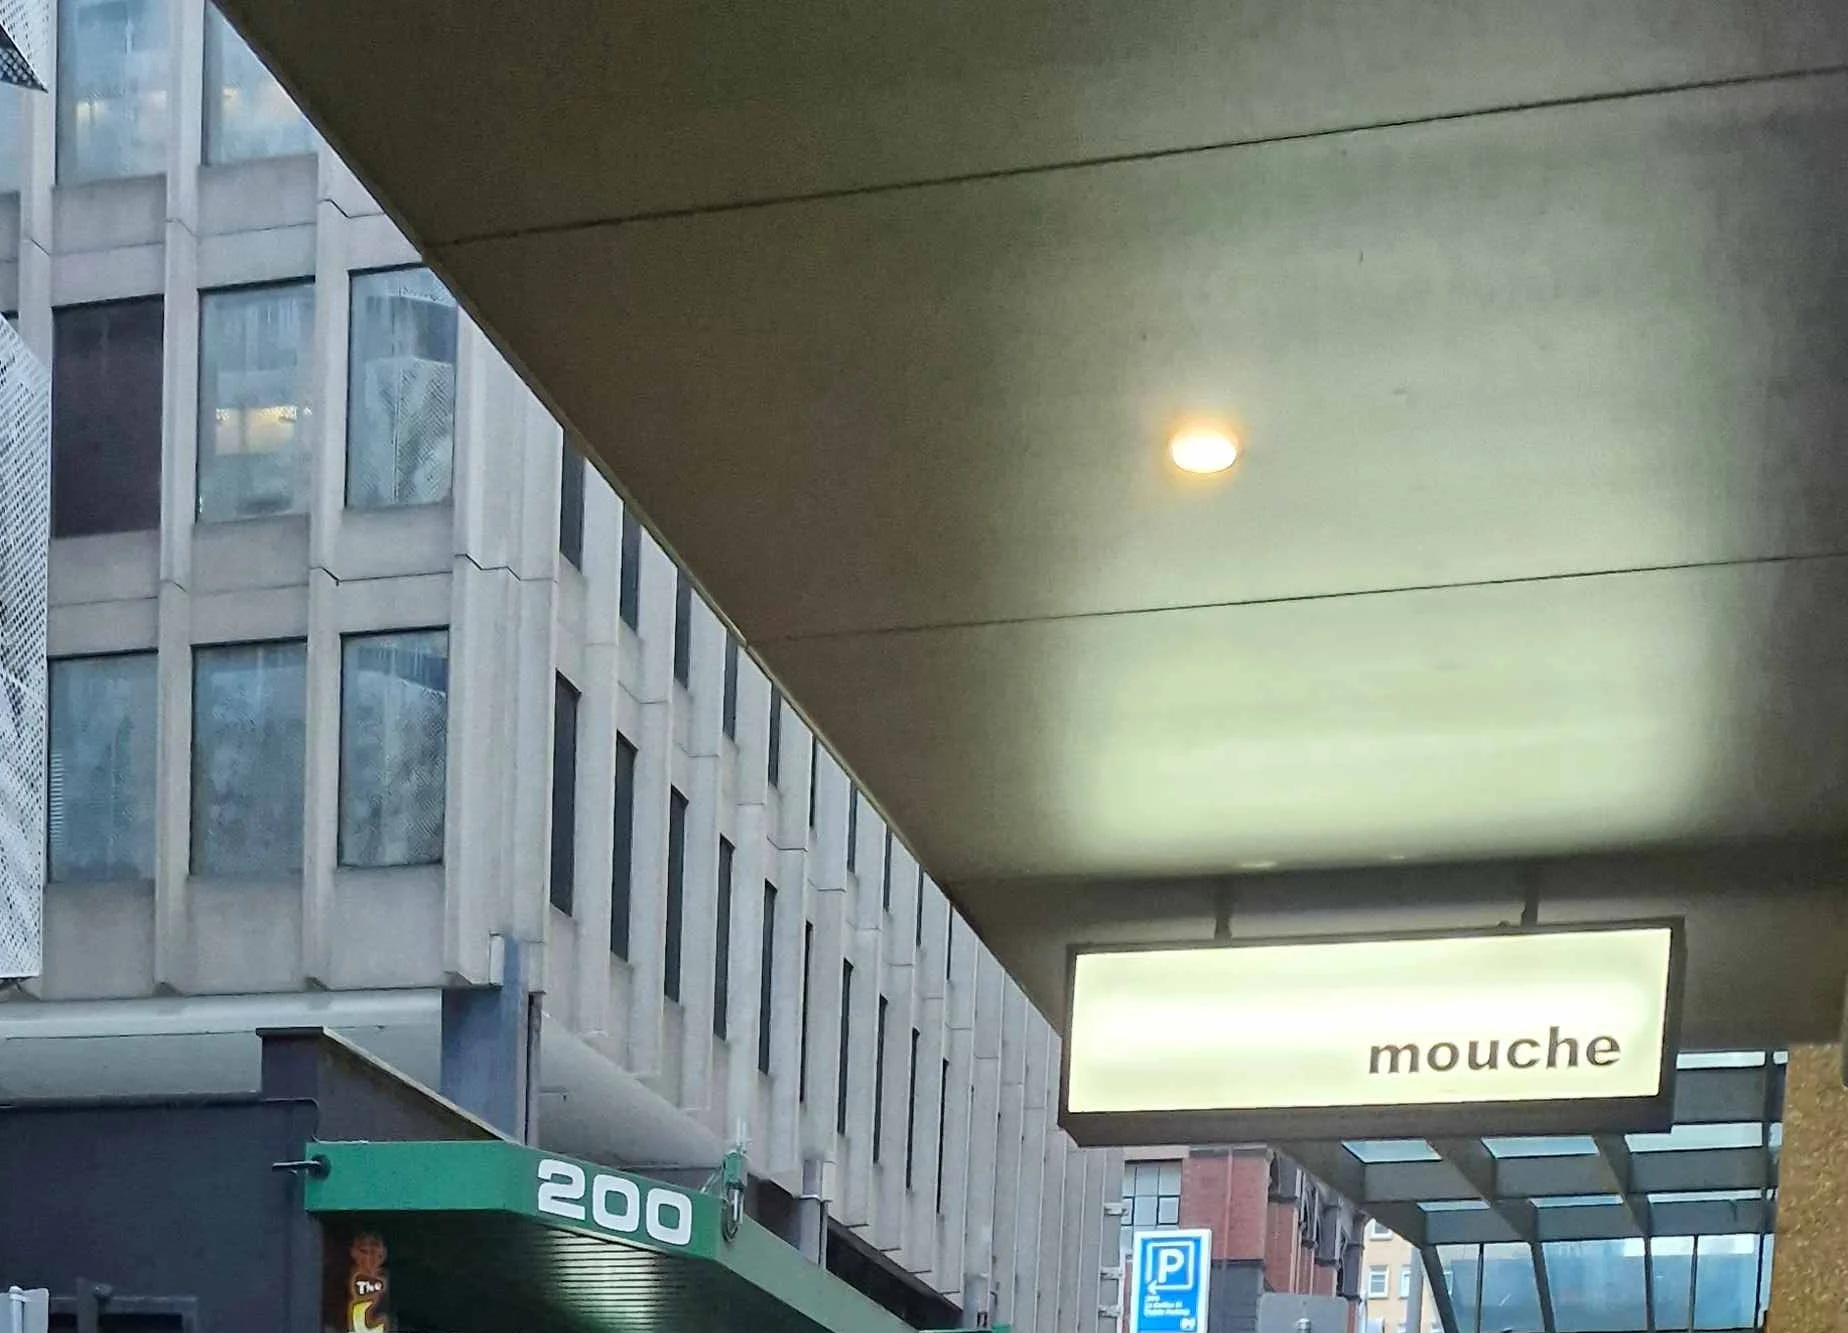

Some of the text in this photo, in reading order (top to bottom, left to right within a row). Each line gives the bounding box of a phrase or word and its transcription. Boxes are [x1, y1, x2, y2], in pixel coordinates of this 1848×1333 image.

[1368, 1026, 1621, 1074] mouche
[537, 1158, 692, 1246] 200
[1158, 1248, 1184, 1283] P
